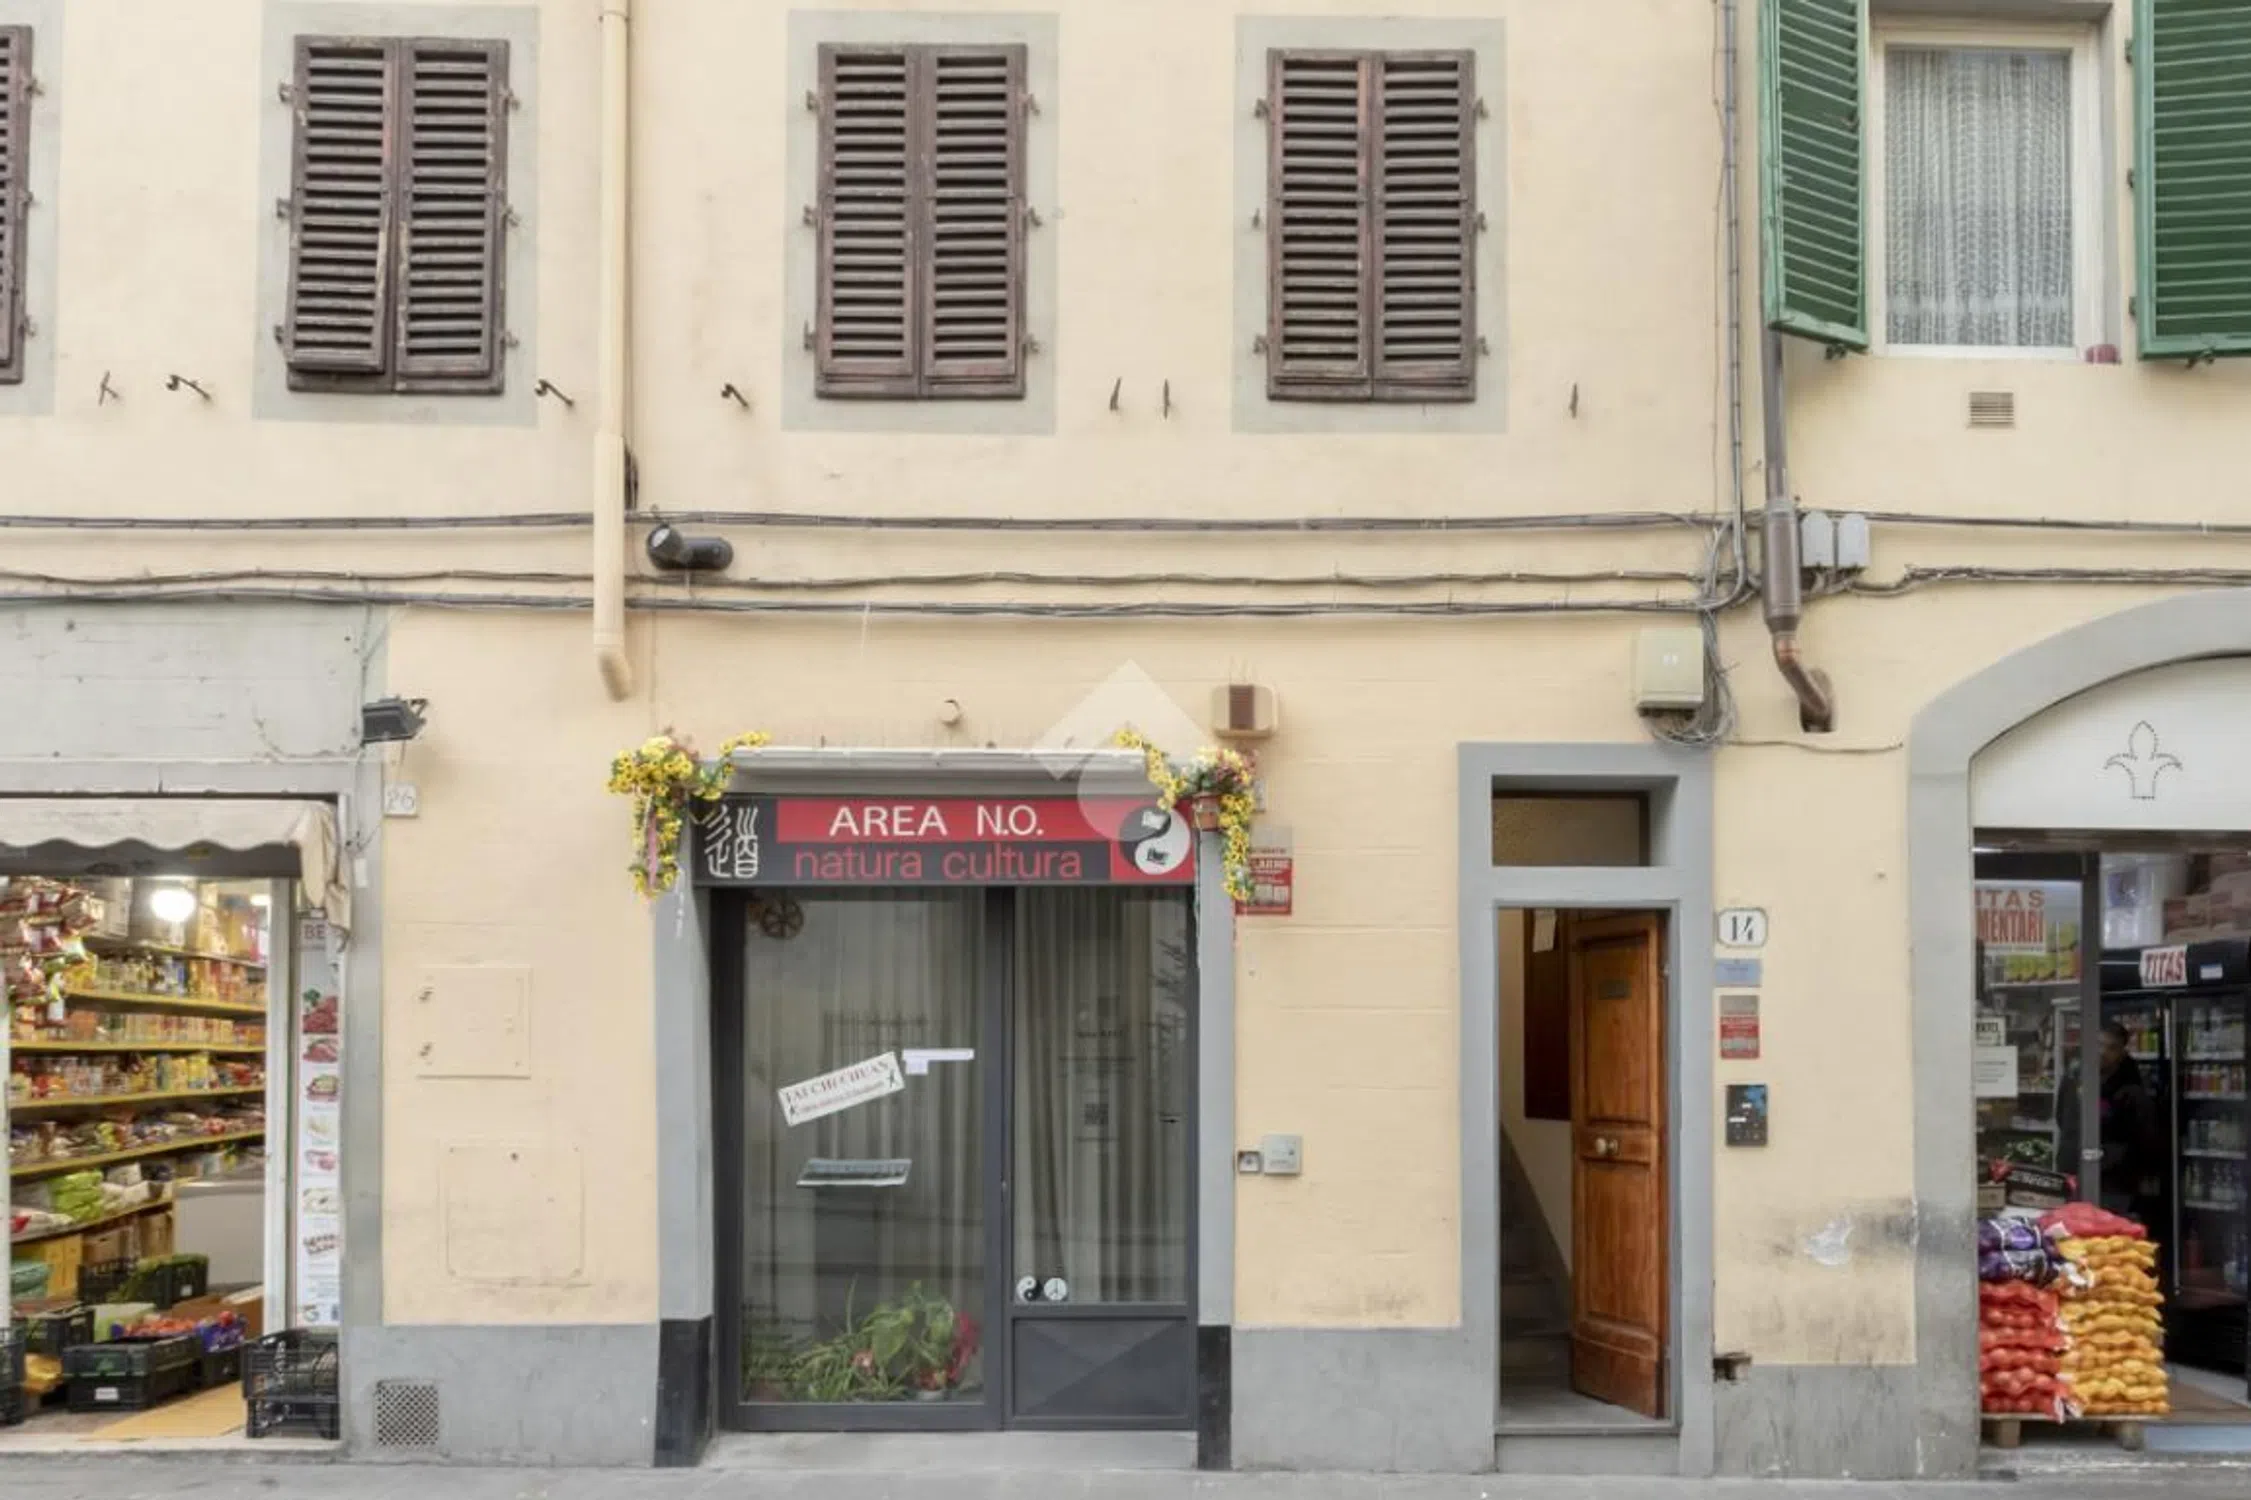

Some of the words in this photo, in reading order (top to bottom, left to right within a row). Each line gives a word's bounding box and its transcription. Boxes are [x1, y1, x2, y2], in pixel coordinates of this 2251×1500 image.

[828, 805, 948, 837] AREA
[976, 804, 1045, 837] N.O.
[794, 846, 923, 879] natura
[941, 842, 1083, 879] cultura
[1731, 915, 1755, 942] 14
